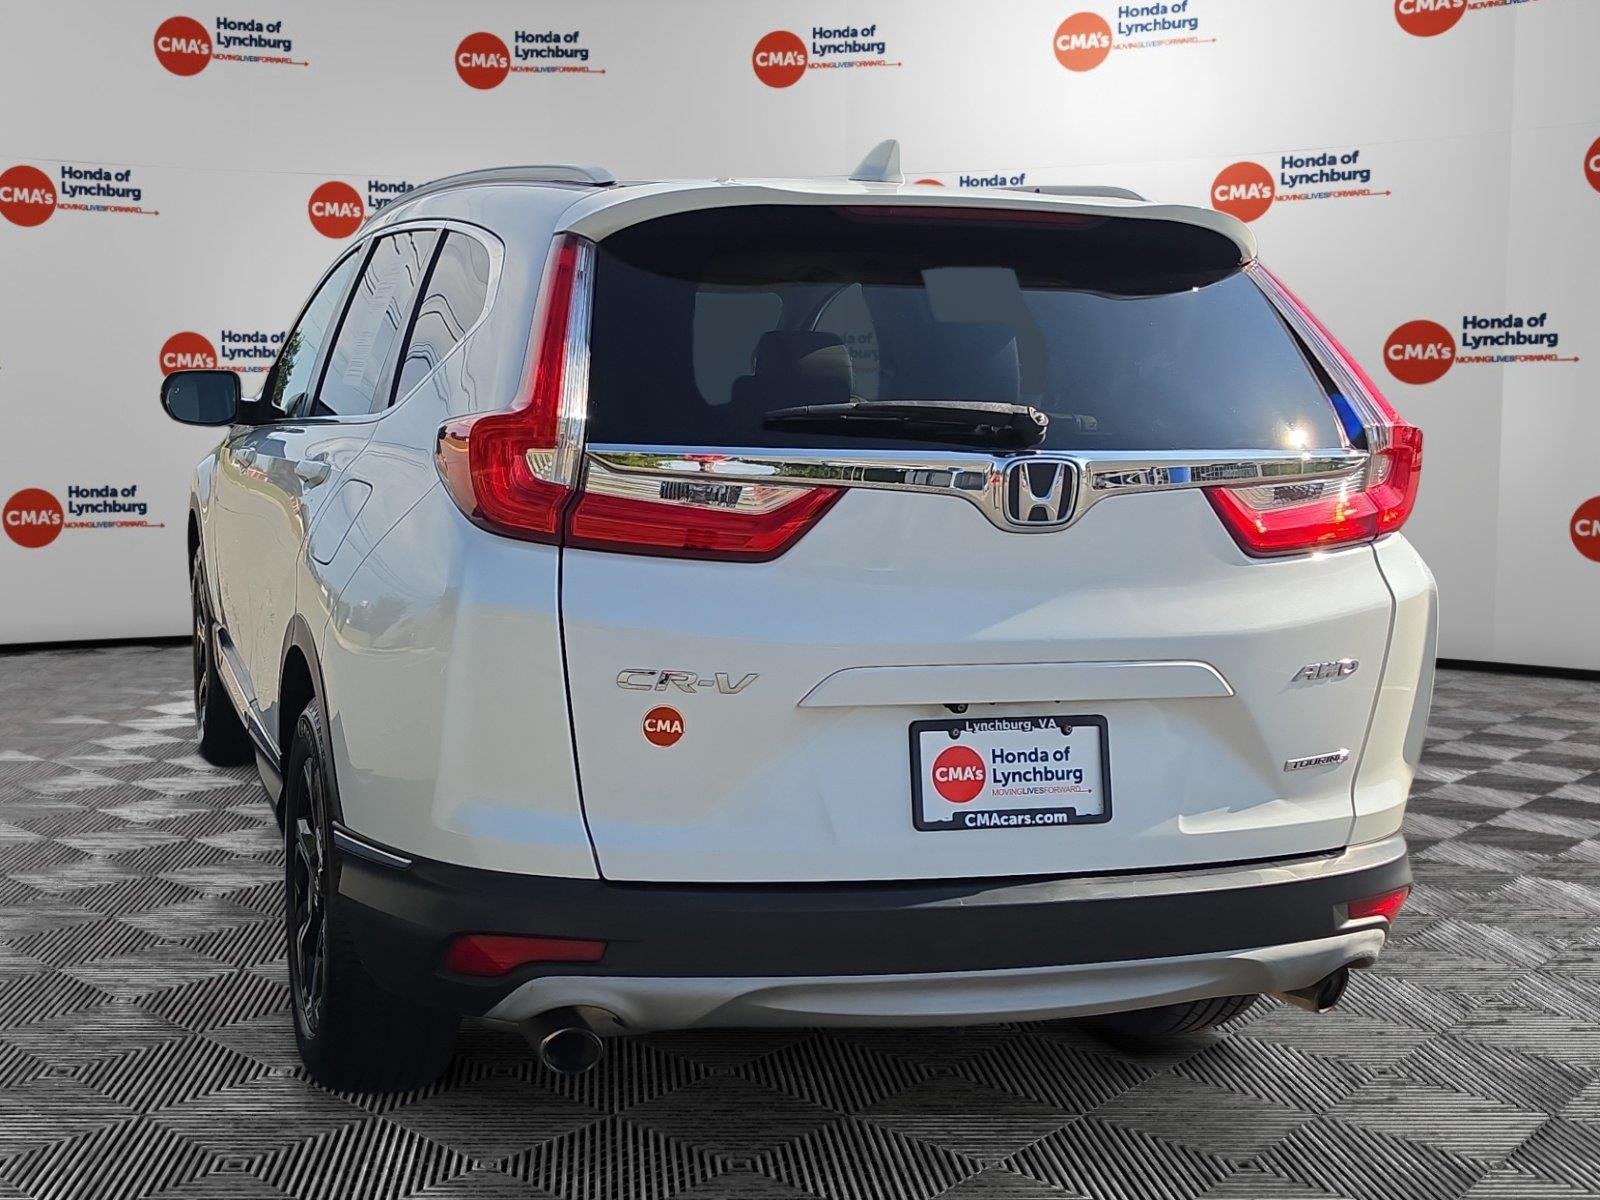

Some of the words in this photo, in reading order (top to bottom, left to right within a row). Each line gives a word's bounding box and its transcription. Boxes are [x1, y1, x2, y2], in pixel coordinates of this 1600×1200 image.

[1118, 3, 1167, 18] Honda
[1171, 0, 1188, 13] of
[1399, 0, 1464, 15] CMAs
[216, 16, 263, 32] Honda
[266, 21, 281, 33] of
[812, 26, 858, 39] Honda
[861, 25, 876, 37] of
[1118, 18, 1198, 36] Lynchburg
[217, 32, 291, 51] Lynchburg
[515, 31, 560, 43] Honda
[564, 31, 579, 43] of
[1056, 32, 1109, 51] CMA's
[158, 37, 209, 55] CMA's
[515, 45, 589, 60] Lynchburg
[813, 42, 885, 56] Lynchburg
[458, 53, 508, 68] CMA's
[756, 51, 805, 67] CMA's
[1281, 156, 1337, 169] Honda
[1341, 151, 1359, 164] of
[61, 166, 111, 181] Honda
[115, 170, 131, 182] of
[959, 175, 1007, 187] Honda
[1010, 173, 1026, 185] of
[1281, 168, 1370, 187] Lynchburg
[61, 181, 141, 201] Lynchburg
[368, 180, 414, 193] Honda
[1214, 182, 1271, 202] CMA's
[0, 187, 53, 205] CMA's
[311, 201, 361, 218] CMA's
[1463, 315, 1523, 329] Honda
[1527, 313, 1547, 327] of
[221, 330, 268, 343] Honda
[271, 332, 285, 343] of
[1462, 331, 1558, 349] Lynchburg
[163, 352, 214, 368] CMA's
[222, 345, 279, 360] Lynchbu
[1388, 343, 1451, 361] CMA's
[68, 486, 118, 498] Honda
[121, 485, 137, 497] of
[68, 500, 147, 516] Lynchburg
[6, 510, 61, 526] CMA's
[616, 669, 760, 694] CR-V
[644, 718, 683, 734] CMA
[1039, 718, 1057, 729] VA
[992, 748, 1048, 764] Honda
[1053, 746, 1070, 762] of
[935, 767, 984, 781] CMA's
[992, 767, 1083, 786] Lynchburg
[965, 812, 1067, 827] CMAcars.com
